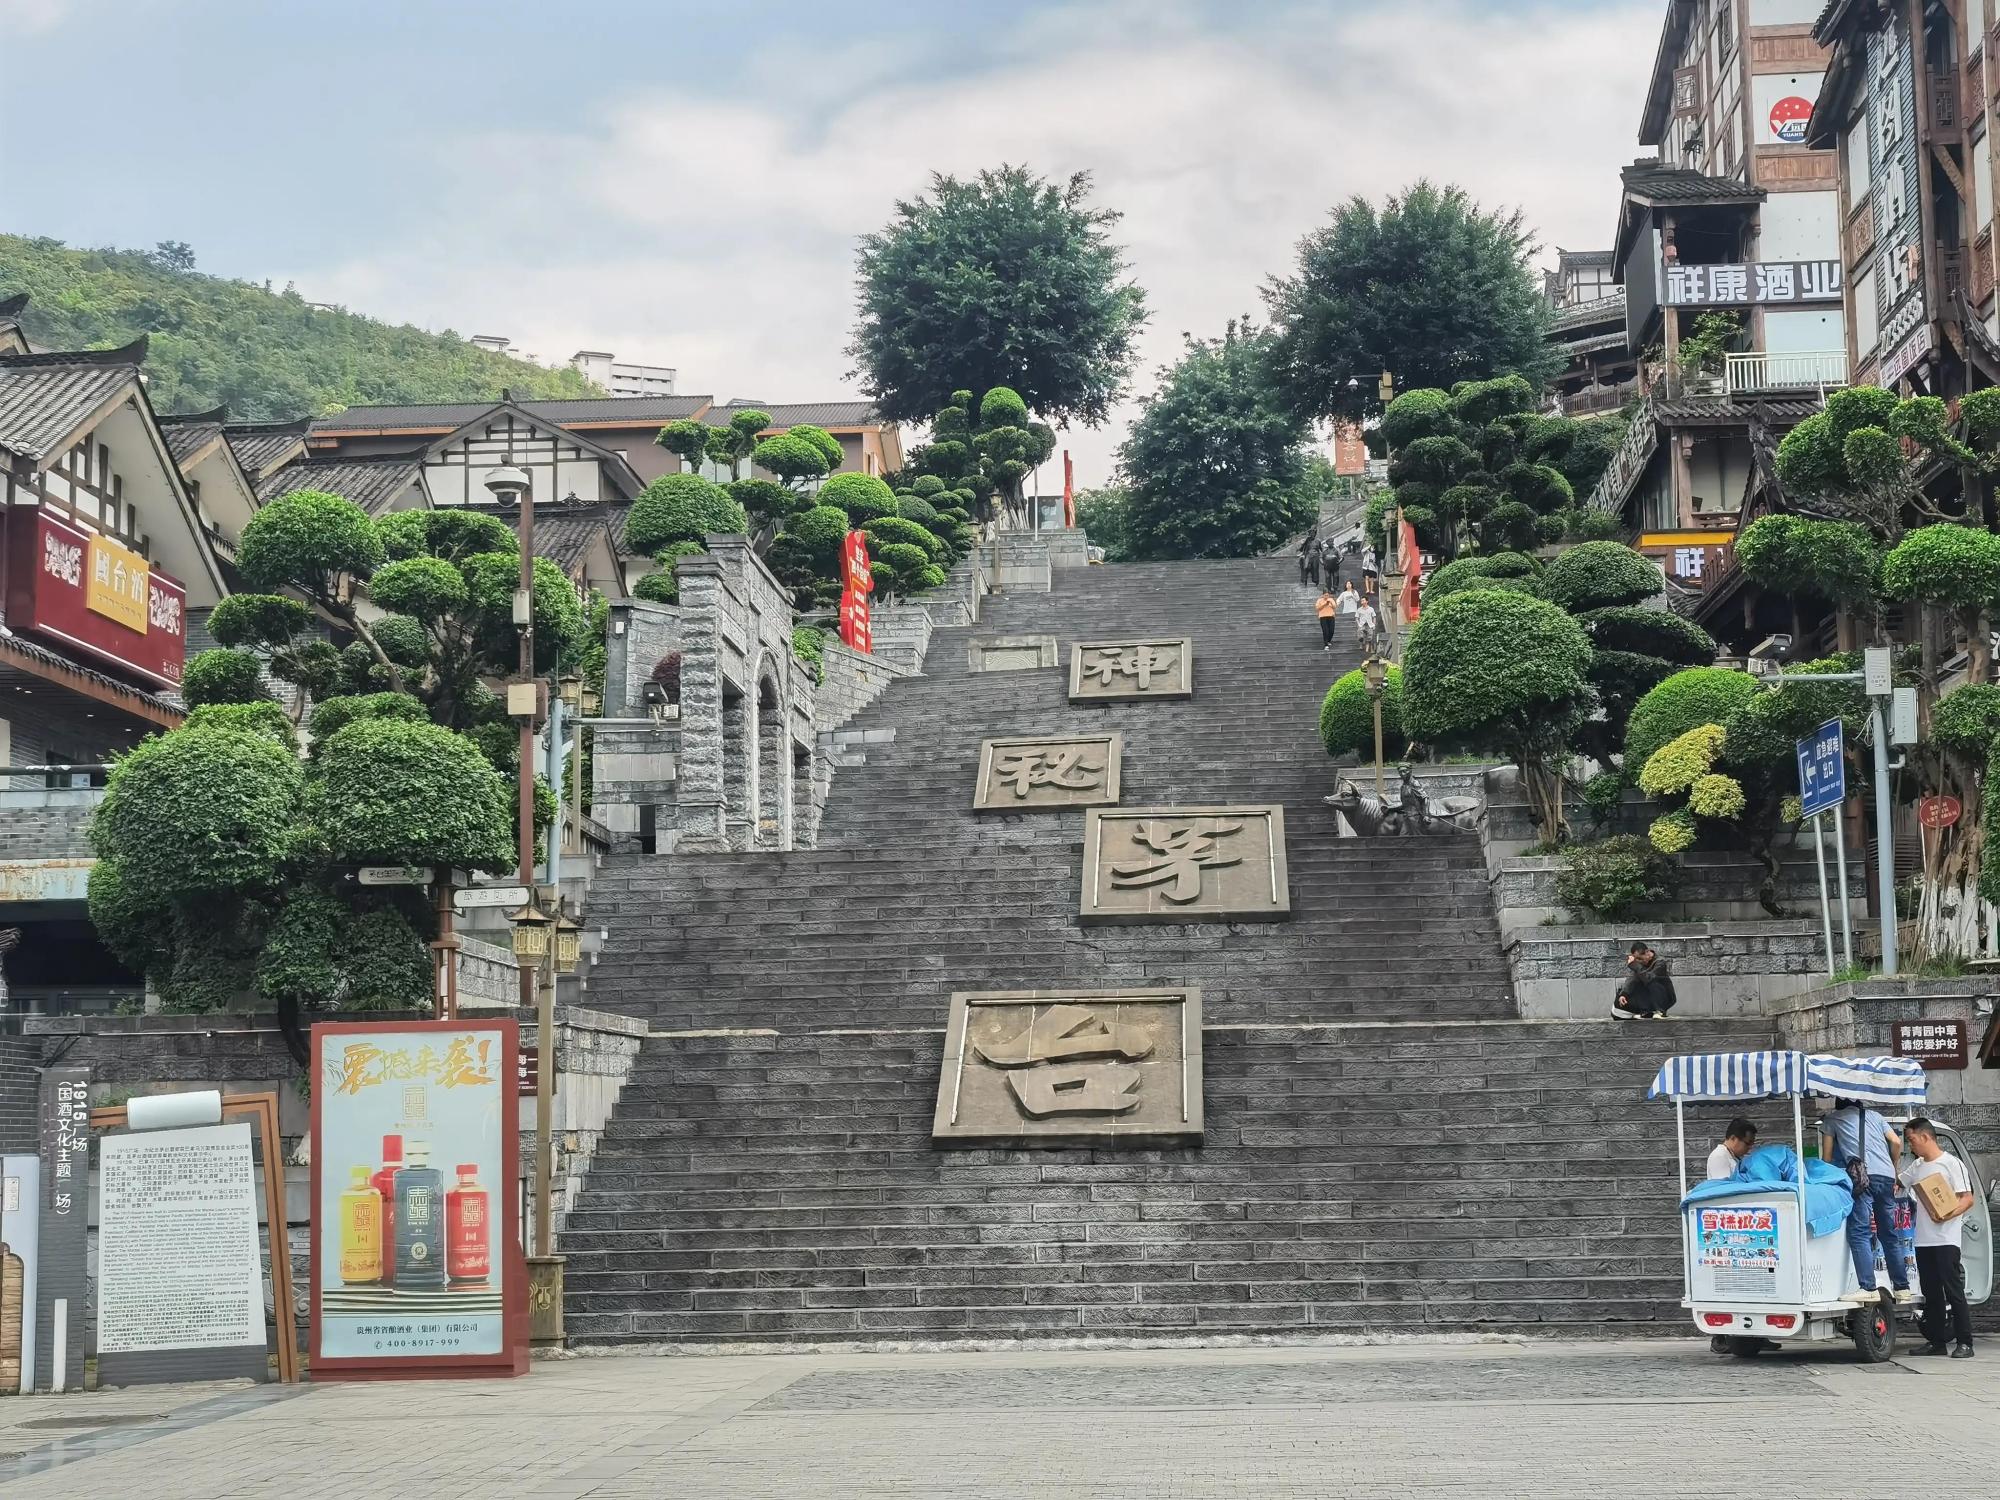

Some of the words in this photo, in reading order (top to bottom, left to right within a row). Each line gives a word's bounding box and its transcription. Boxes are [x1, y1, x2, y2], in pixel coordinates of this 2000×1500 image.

[1667, 262, 1842, 303] 祥康酒业
[1083, 645, 1177, 691] 神
[995, 749, 1103, 798] 秘
[1111, 819, 1243, 902] 茅
[1901, 1025, 1958, 1037] 青青园中草
[1901, 1039, 1958, 1050] 请您爱护好
[973, 1004, 1154, 1121] 台
[387, 1339, 460, 1347] 400-8917-999
